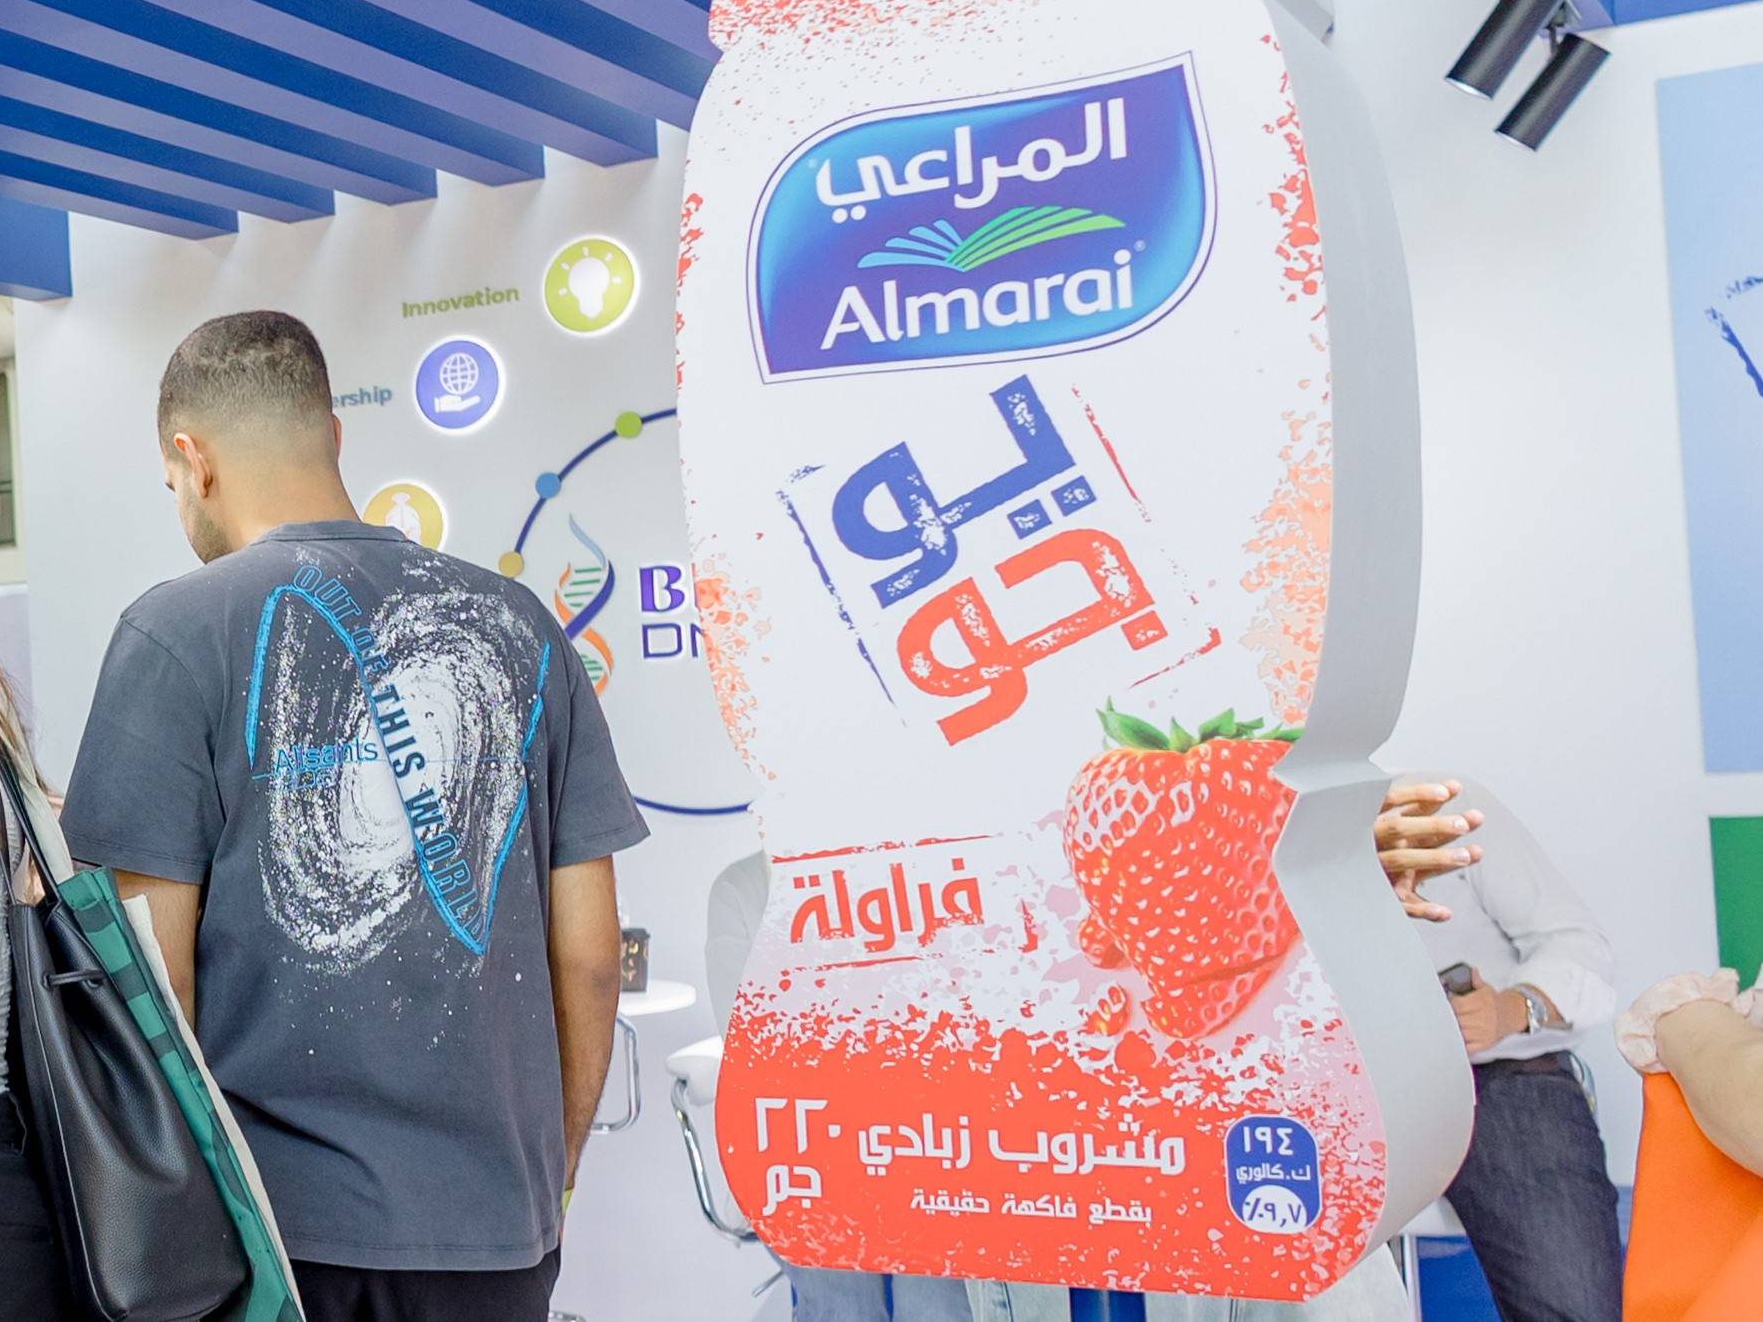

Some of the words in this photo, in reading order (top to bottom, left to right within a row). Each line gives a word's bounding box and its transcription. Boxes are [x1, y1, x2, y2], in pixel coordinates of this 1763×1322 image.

[813, 97, 1127, 224] المراعي
[401, 287, 520, 319] Innovation
[820, 249, 1134, 351] Almarai
[331, 386, 393, 409] ership
[294, 565, 363, 622] OUT
[371, 684, 426, 779] THIS
[790, 857, 985, 954] فراولة
[858, 1113, 972, 1177] زبادي
[988, 1112, 1186, 1176] مشروب
[1243, 1126, 1294, 1156] ١٩٤
[762, 1161, 823, 1217] جم
[910, 1188, 990, 1216] حقيقية
[1001, 1190, 1078, 1219] فاكهة
[1089, 1196, 1153, 1226] بقطع
